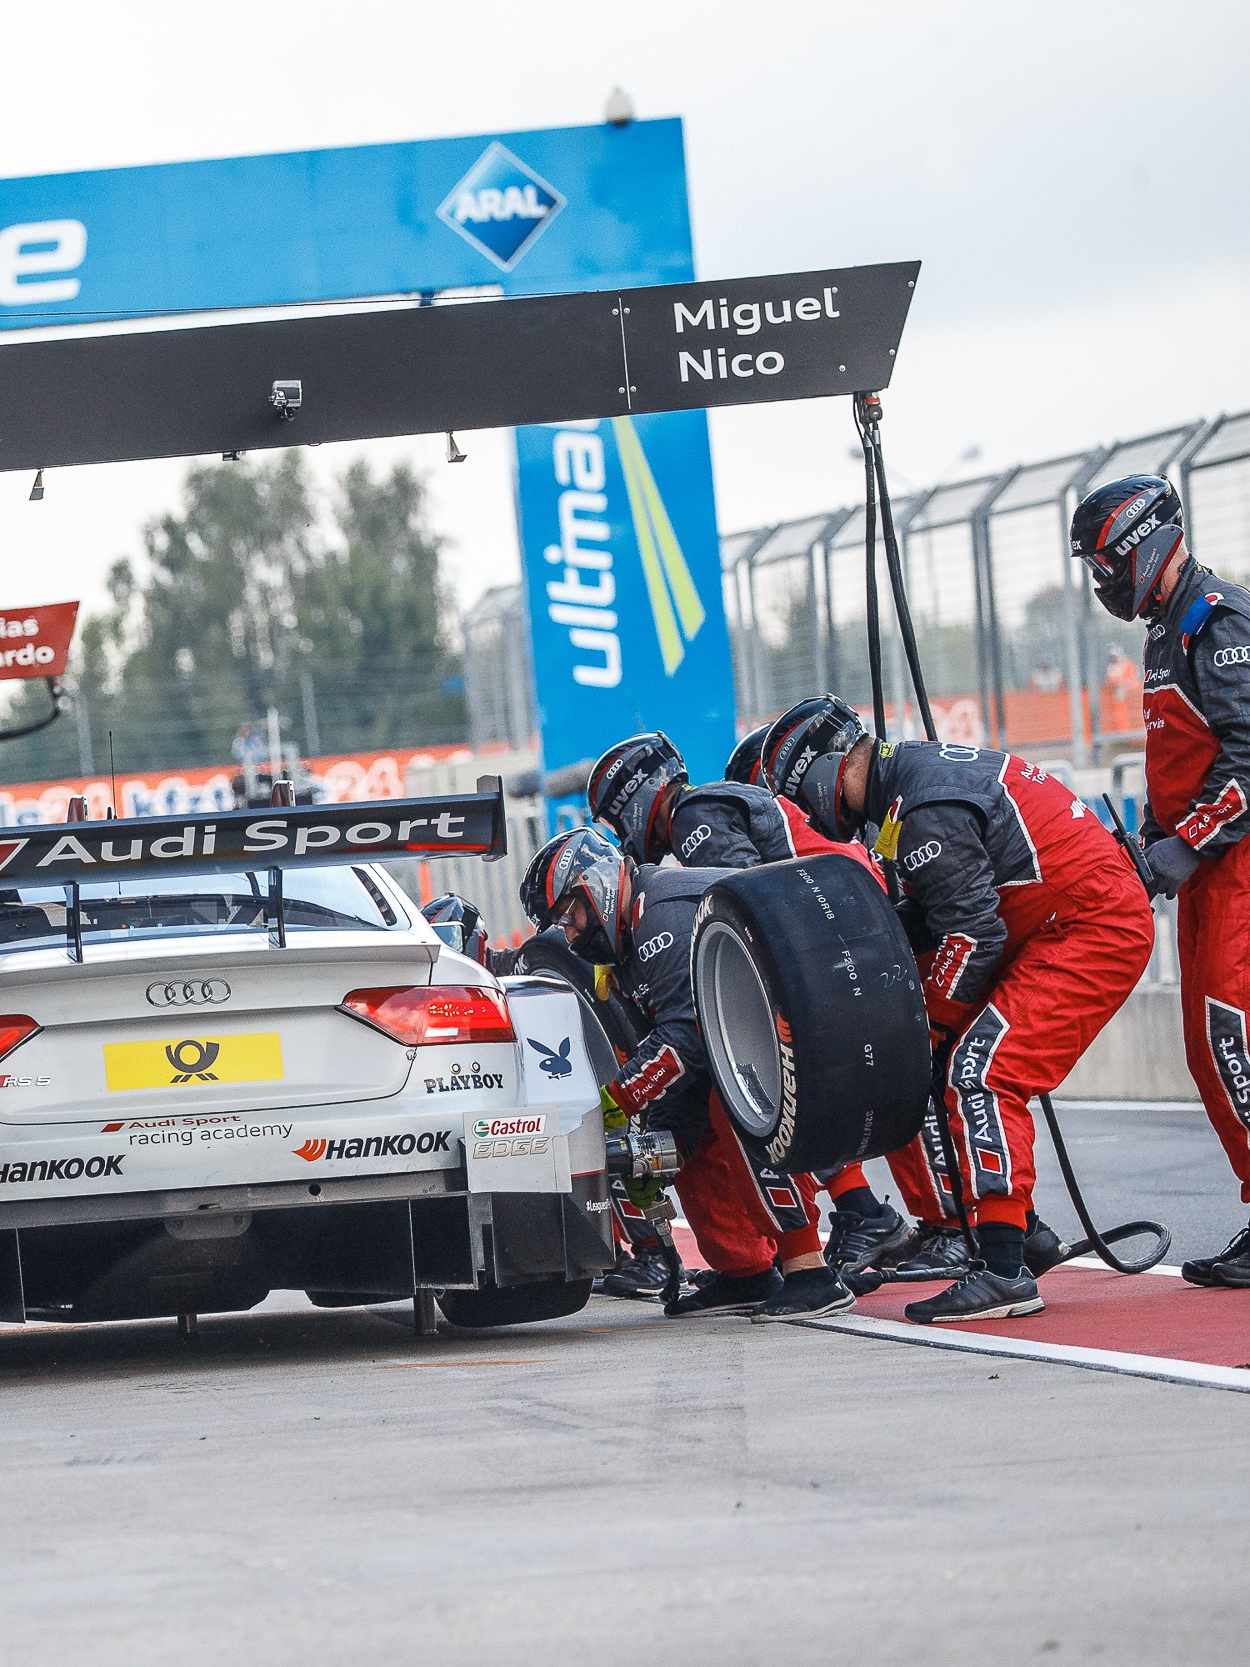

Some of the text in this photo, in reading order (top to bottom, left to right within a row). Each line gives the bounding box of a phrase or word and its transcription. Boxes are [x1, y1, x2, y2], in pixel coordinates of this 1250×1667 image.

[455, 183, 550, 225] ARAL
[673, 287, 840, 336] Miguel
[679, 349, 785, 383] Nico
[544, 418, 623, 688] ultima
[1115, 513, 1162, 556] uvex
[608, 768, 649, 815] uvex
[784, 745, 818, 796] uvex
[36, 813, 466, 867] Audi Sport
[841, 950, 862, 997] F200 N
[864, 1044, 875, 1067] G77
[1219, 1036, 1250, 1105] Sport
[1, 1074, 52, 1088] RS 5
[423, 1073, 504, 1095] PLAYBOY
[128, 1114, 241, 1129] Audi Sport
[129, 1122, 293, 1146] racing academy
[490, 1117, 542, 1136] Castrol
[968, 1092, 993, 1143] Audi
[471, 1136, 550, 1160] EDGE
